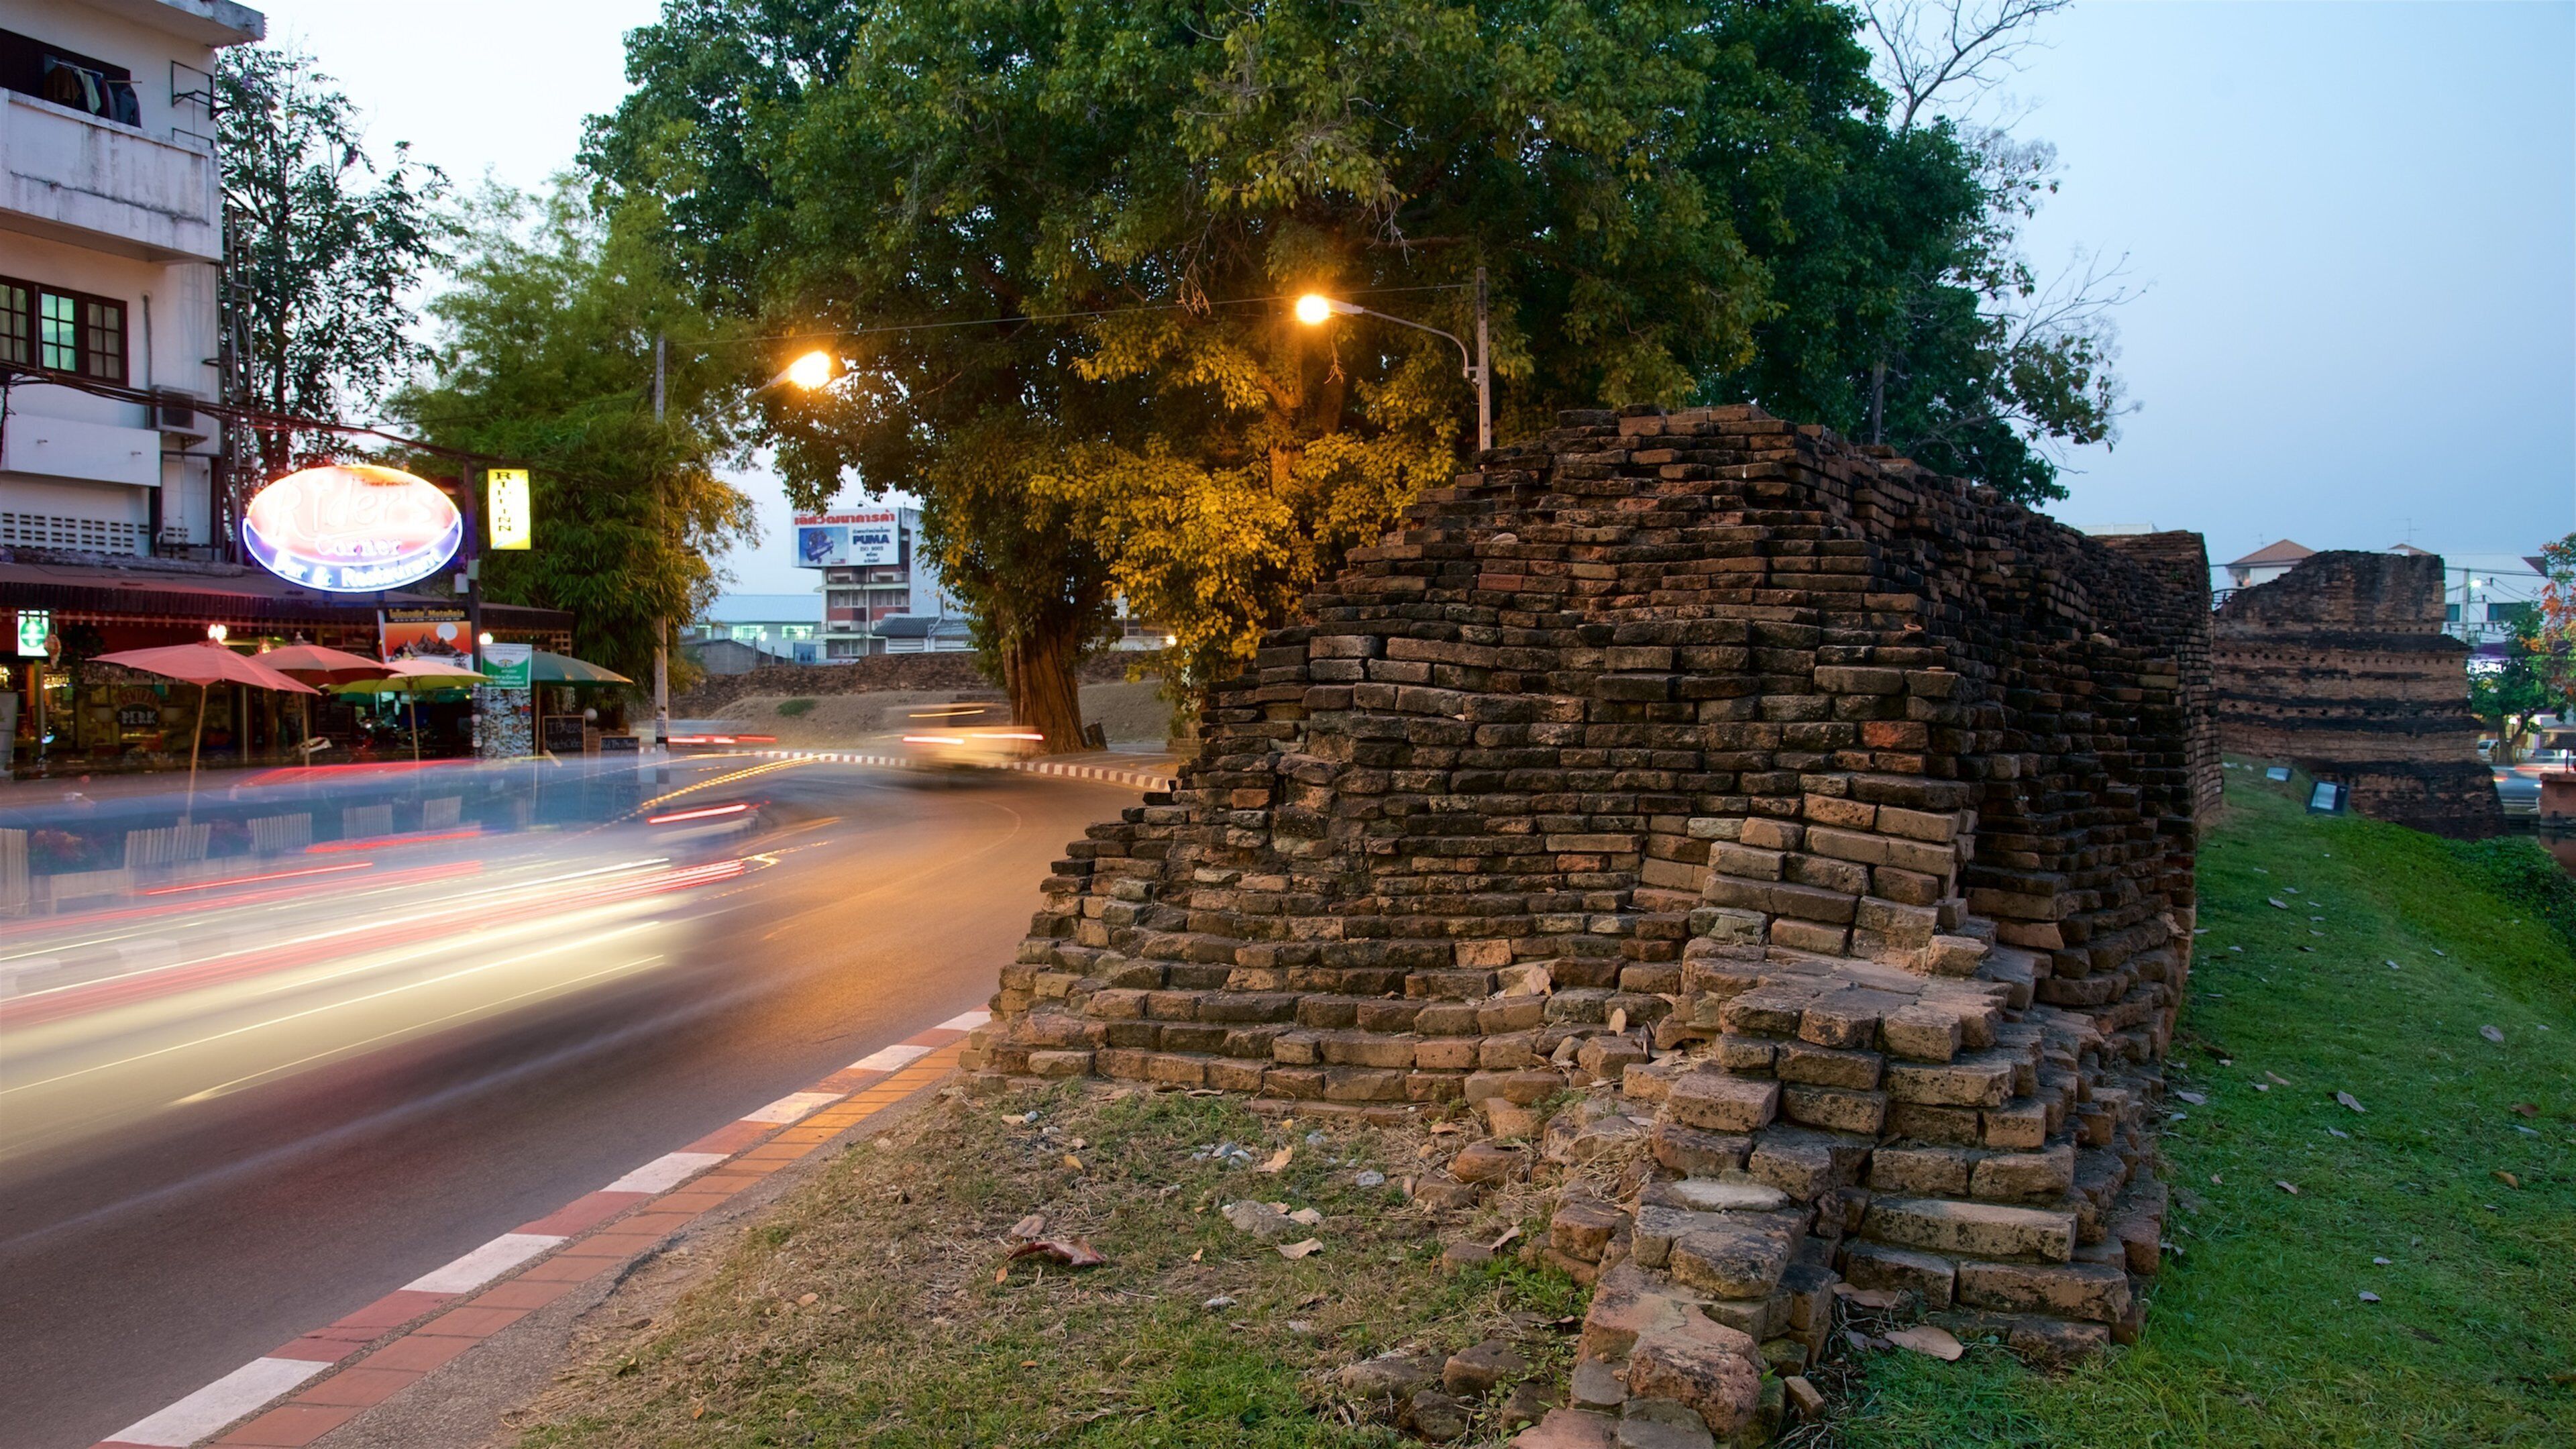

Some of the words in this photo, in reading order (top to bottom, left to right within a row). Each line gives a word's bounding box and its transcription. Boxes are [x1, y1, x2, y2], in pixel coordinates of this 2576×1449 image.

[266, 476, 436, 541] Rider's
[315, 539, 402, 556] Corner
[853, 534, 890, 545] PUMA
[273, 549, 307, 580] Bar
[312, 566, 332, 587] &
[341, 549, 442, 588] Restaurant
[121, 710, 156, 724] PERK
